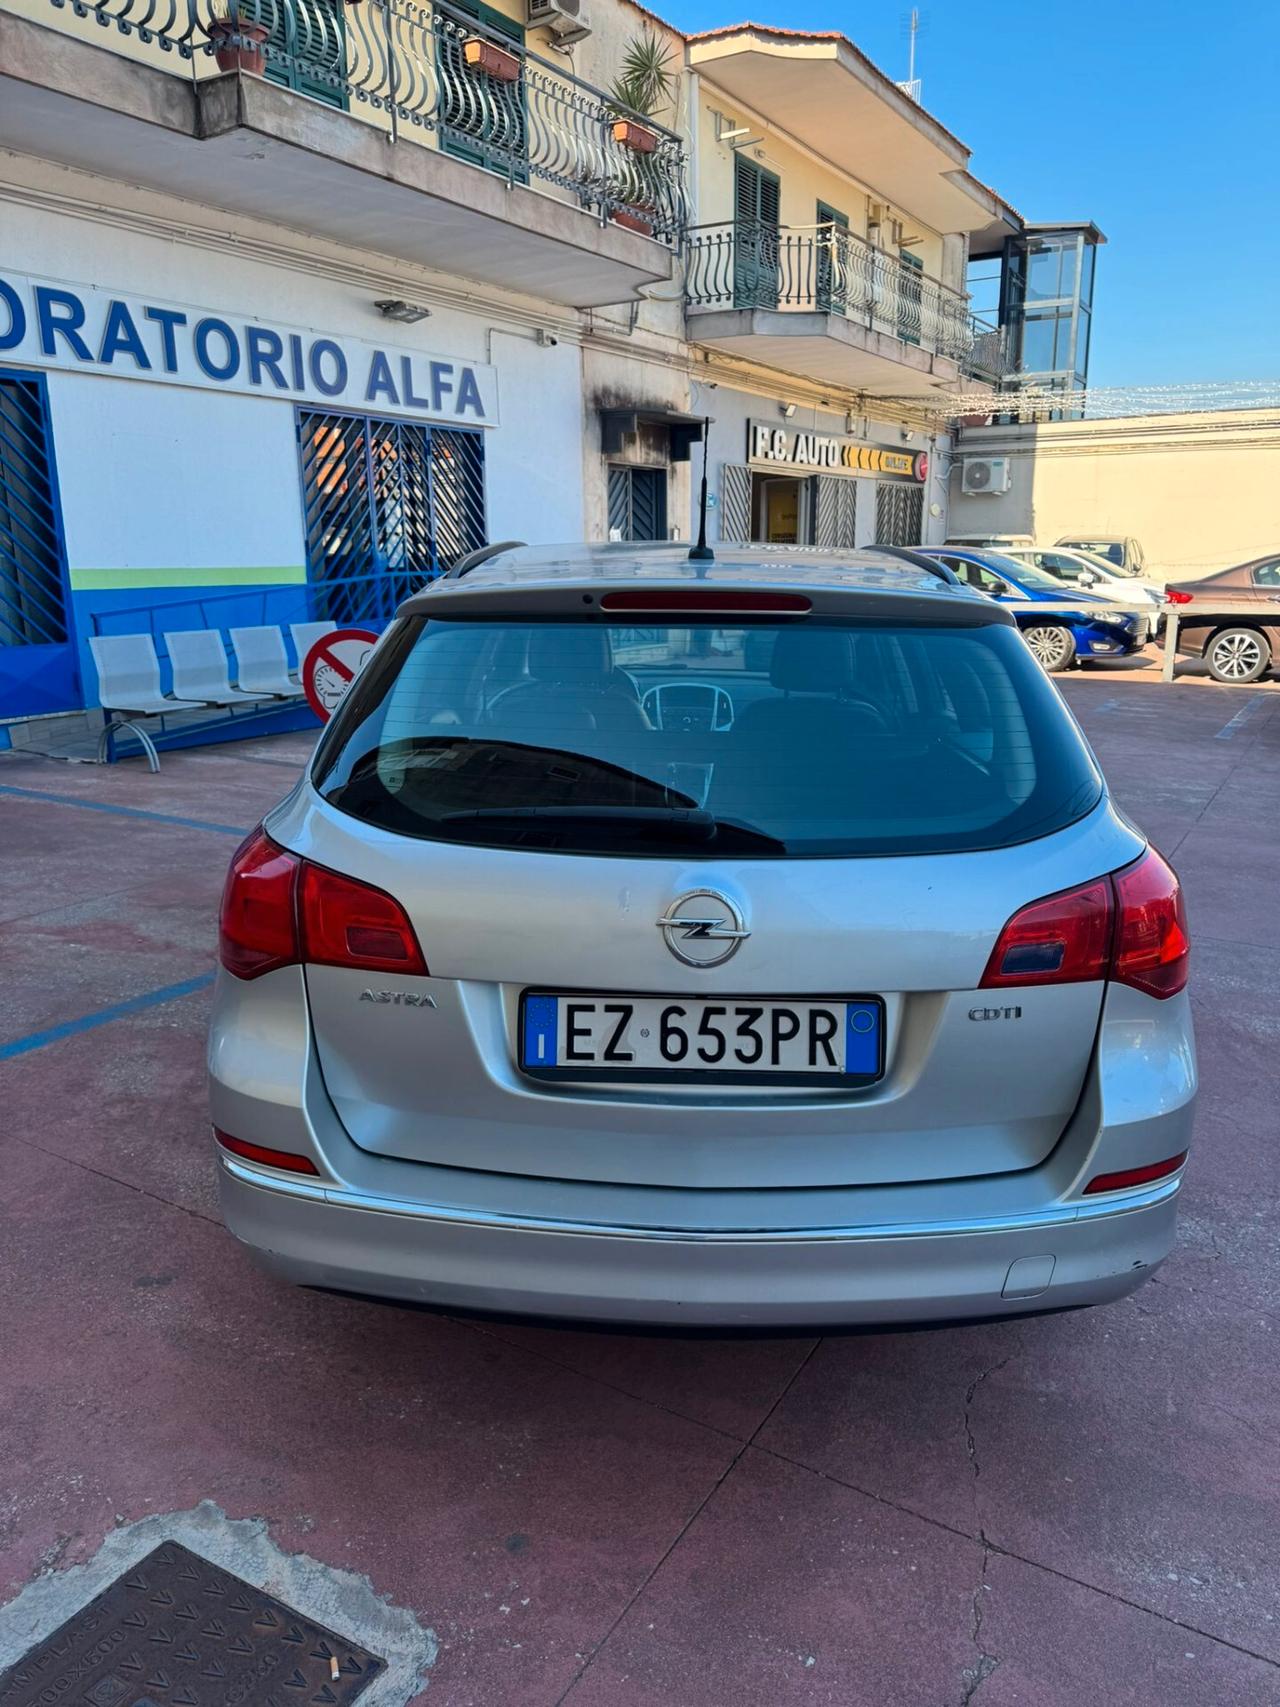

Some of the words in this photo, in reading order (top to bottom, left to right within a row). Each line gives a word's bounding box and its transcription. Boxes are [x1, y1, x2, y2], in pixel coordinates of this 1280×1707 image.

[366, 350, 486, 418] ALFA
[755, 425, 792, 461] F.C.
[795, 433, 840, 467] AUTO
[359, 988, 438, 1009] ASTRA
[967, 1006, 1022, 1022] CDTI
[566, 1003, 634, 1062] EZ
[660, 1005, 839, 1067] 653PR
